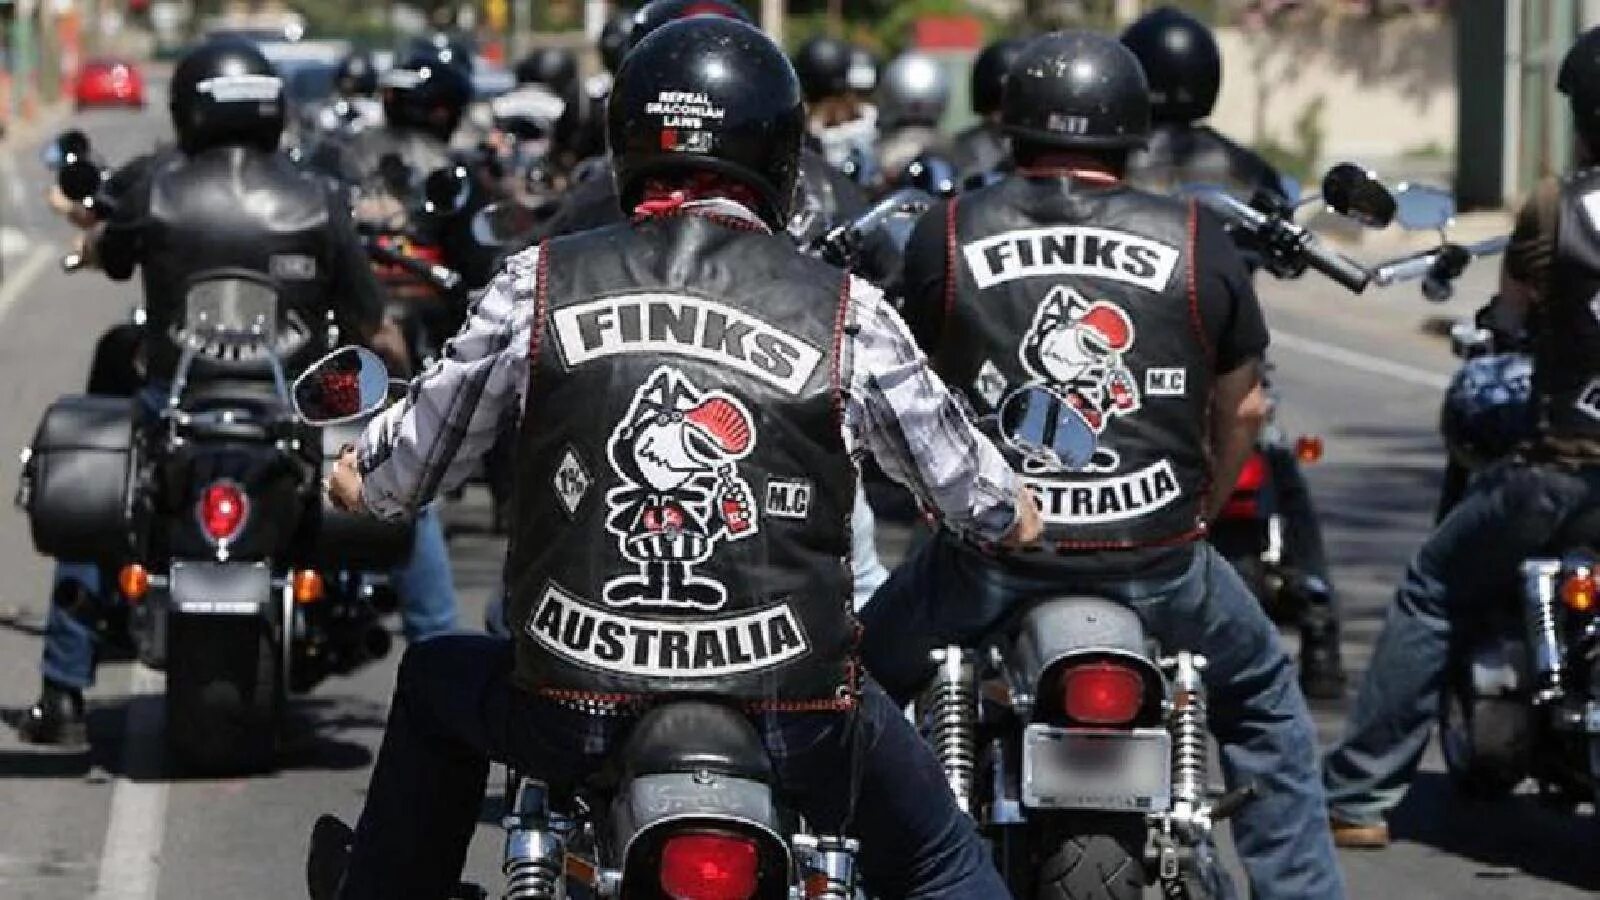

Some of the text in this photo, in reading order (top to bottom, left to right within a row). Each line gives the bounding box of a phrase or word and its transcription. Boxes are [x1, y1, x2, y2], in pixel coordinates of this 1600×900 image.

[645, 102, 724, 118] DRACONIAN
[659, 91, 708, 103] REPEAL
[664, 115, 702, 129] LAWS
[983, 235, 1161, 278] FINKS
[576, 302, 800, 378] FINKS
[1024, 467, 1175, 515] STRALIA
[535, 596, 800, 669] AUSTRALIA
